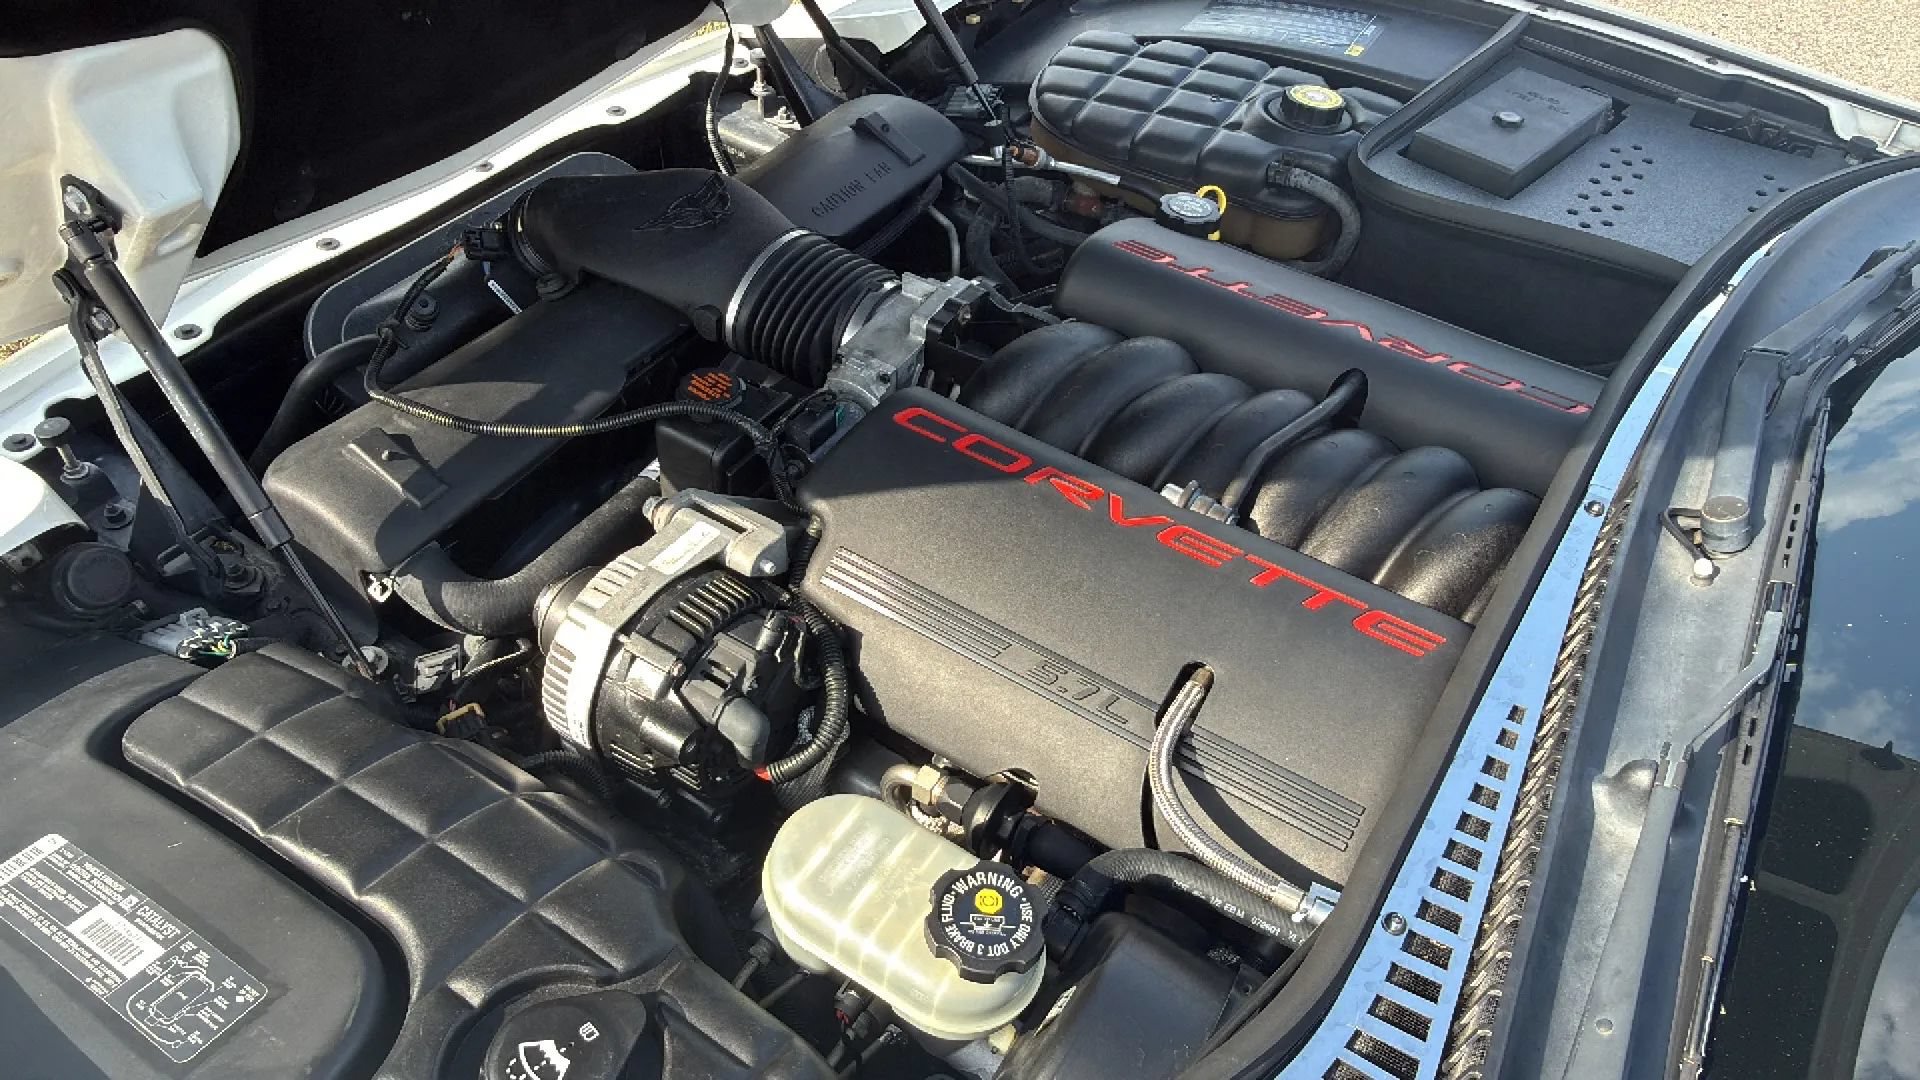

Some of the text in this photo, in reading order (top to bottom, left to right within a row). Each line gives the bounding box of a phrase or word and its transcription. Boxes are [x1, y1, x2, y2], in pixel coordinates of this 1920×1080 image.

[1112, 239, 1593, 415] CORVETTE
[893, 406, 1447, 658] CORVETTE
[1025, 658, 1129, 725] 5.7L
[952, 871, 1024, 899] WARNING
[136, 905, 181, 939] CATALYST
[941, 893, 1033, 957] USE ONLY DOT 3 BRAKE FLUID
